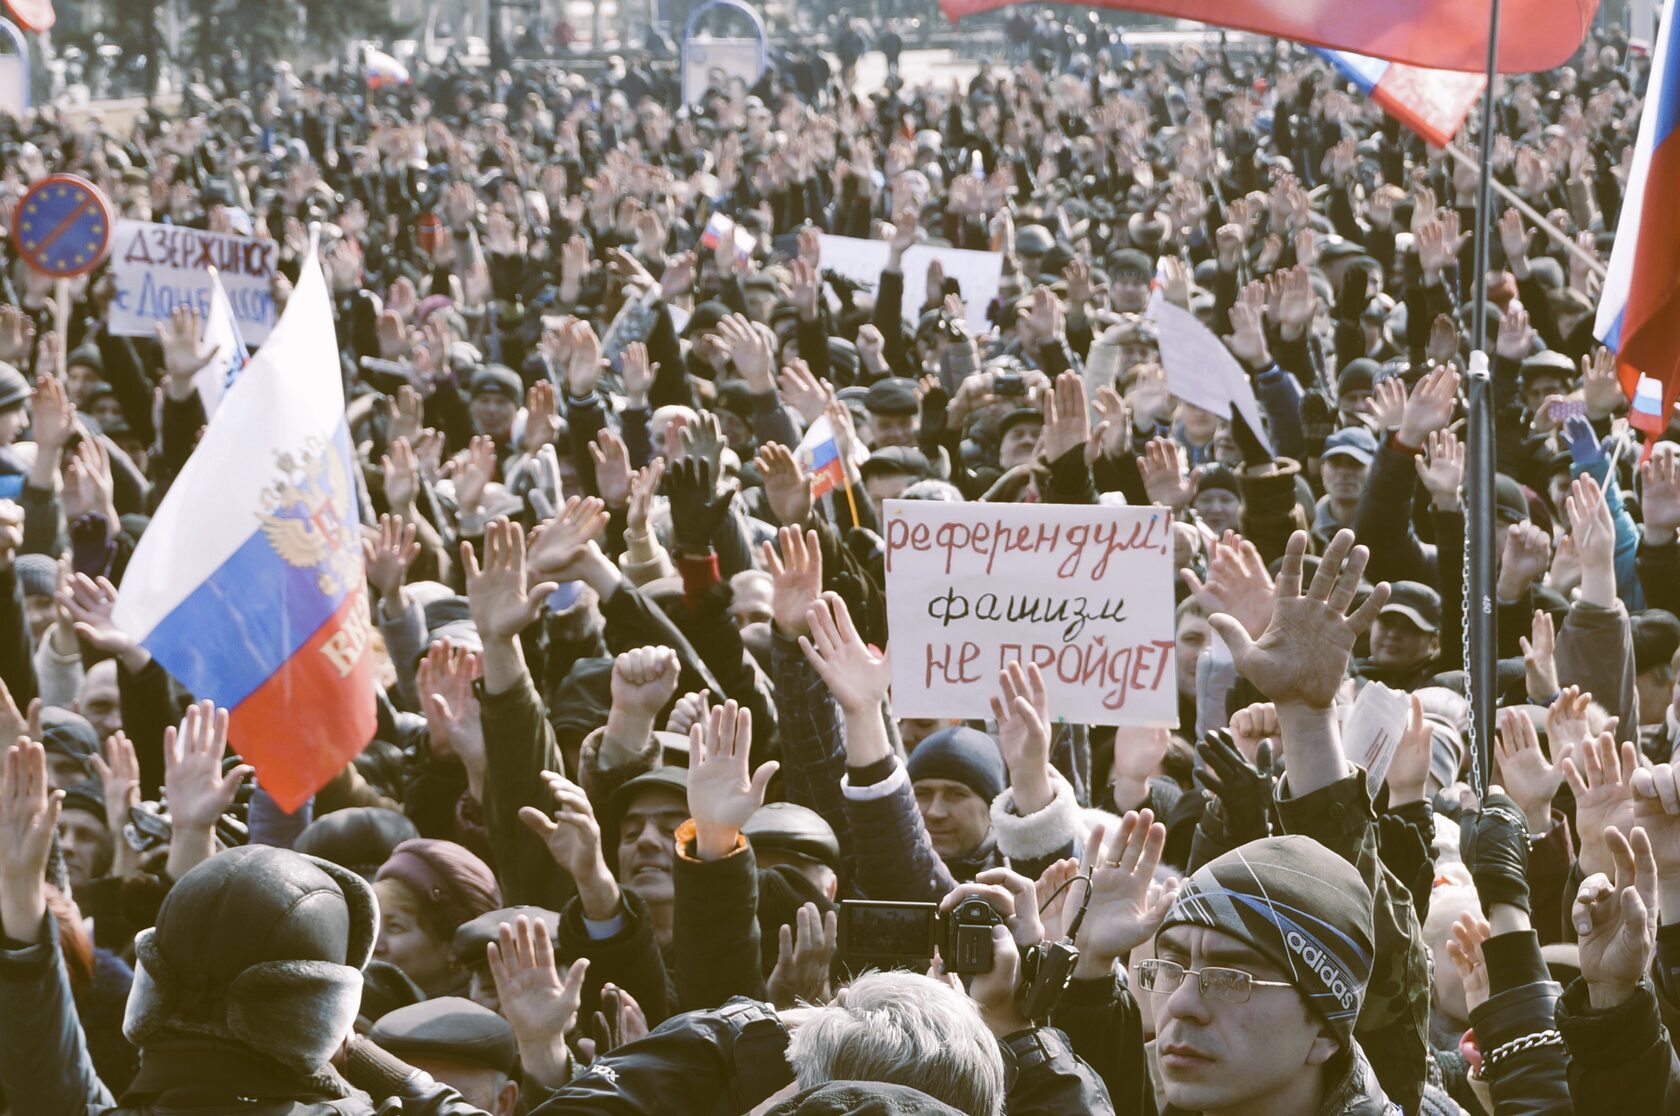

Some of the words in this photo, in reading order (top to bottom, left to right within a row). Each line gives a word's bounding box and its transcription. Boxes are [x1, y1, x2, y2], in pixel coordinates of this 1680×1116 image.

[885, 510, 1172, 580] референдум!
[927, 586, 1127, 642] фашизм
[1286, 931, 1354, 1010] adidas
